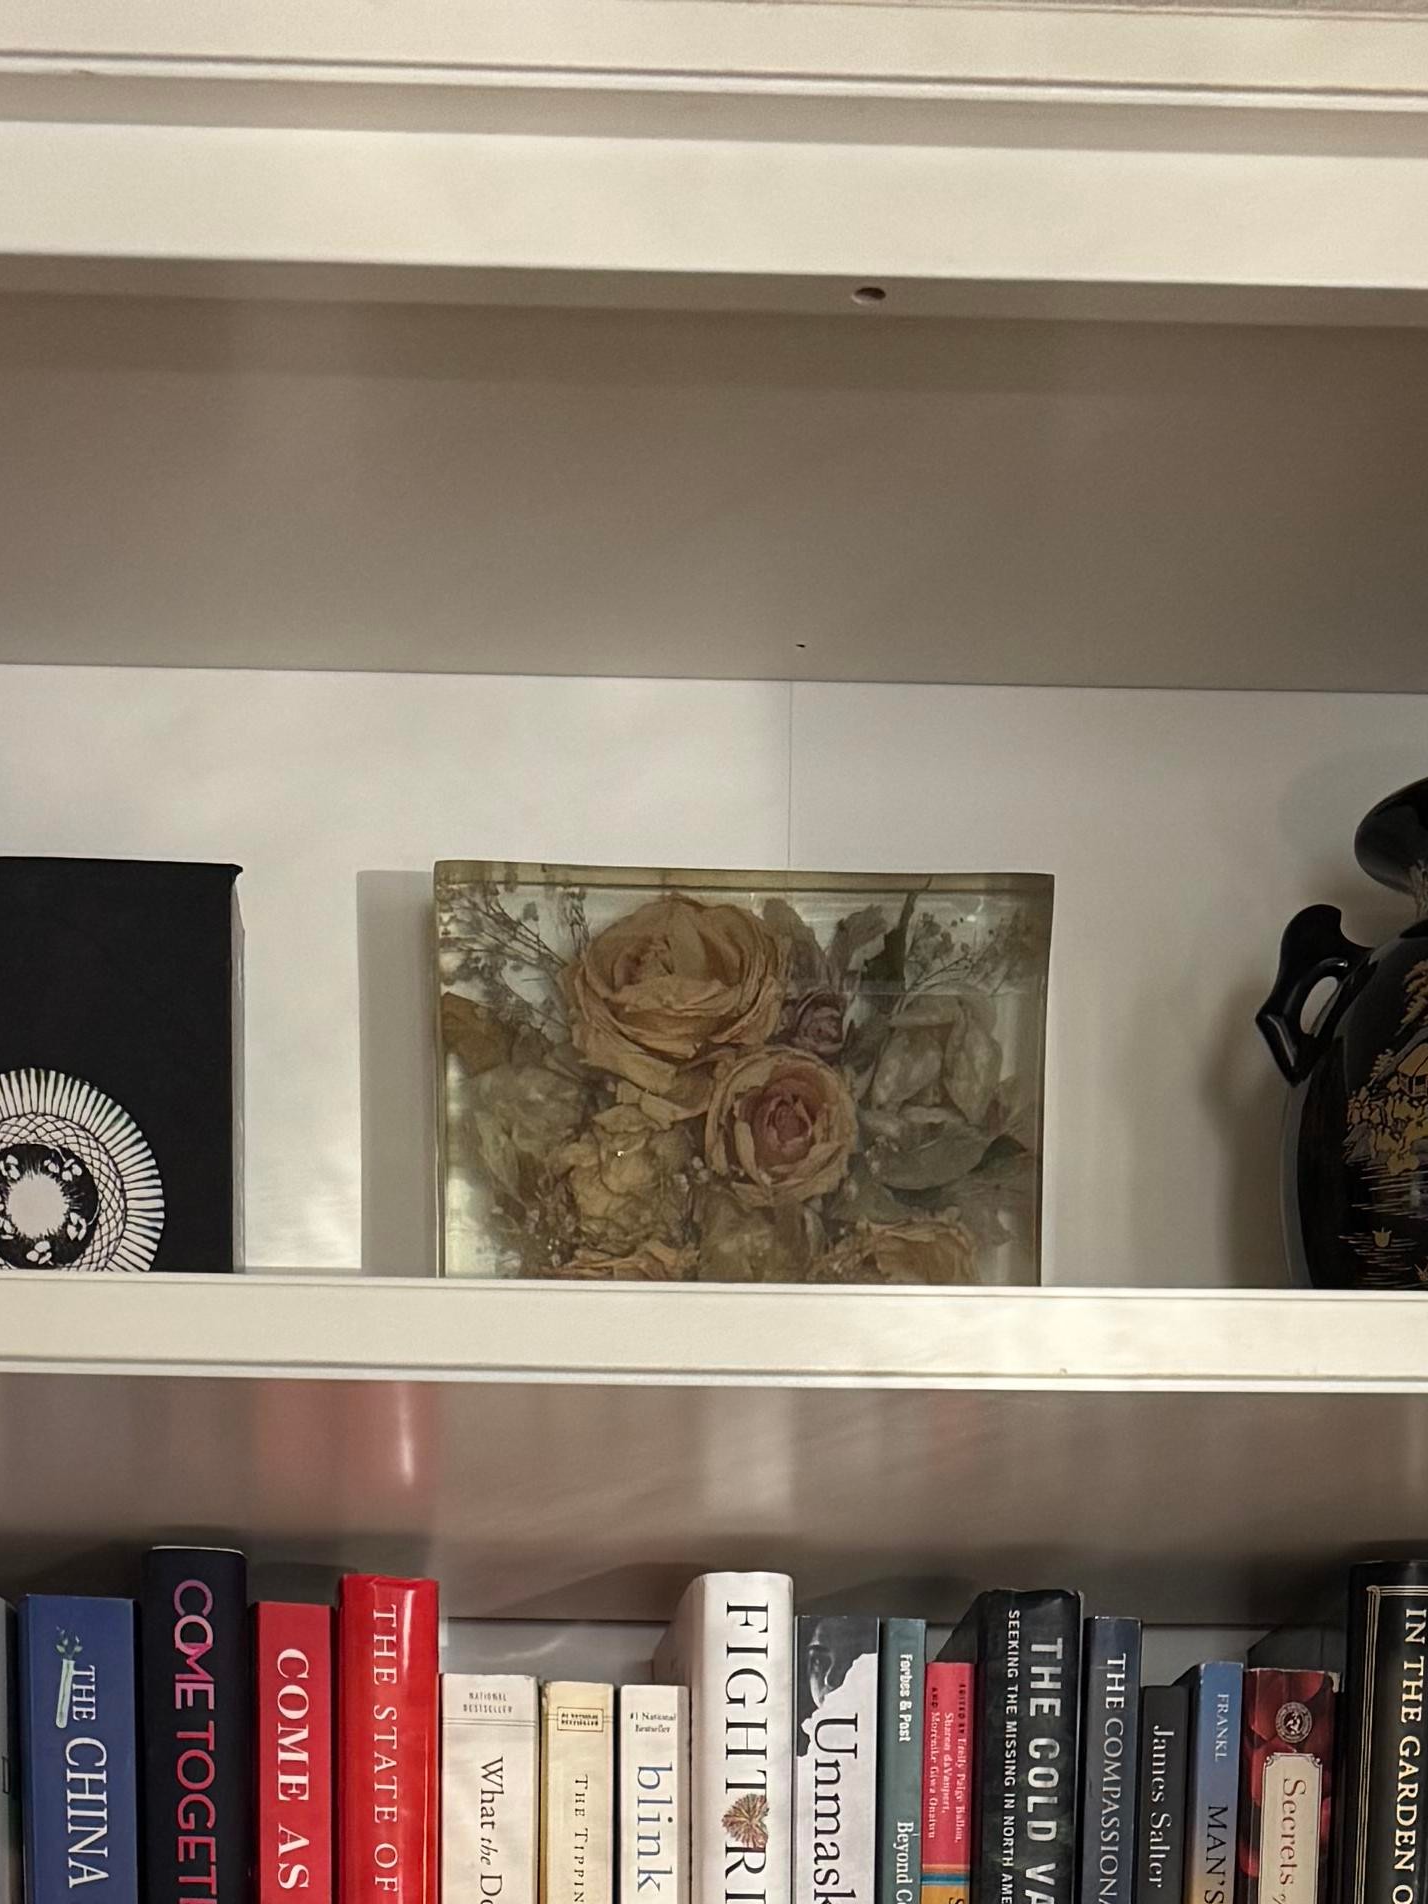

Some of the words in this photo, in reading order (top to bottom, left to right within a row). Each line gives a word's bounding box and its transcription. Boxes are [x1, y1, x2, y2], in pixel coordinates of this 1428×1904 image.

[1027, 1637, 1065, 1723] THE
[1153, 1725, 1170, 1803] James
[1215, 1694, 1230, 1762] FRANKL
[636, 1763, 675, 1893] blink
[1026, 1735, 1062, 1840] COLD
[1150, 1807, 1169, 1888] Salter
